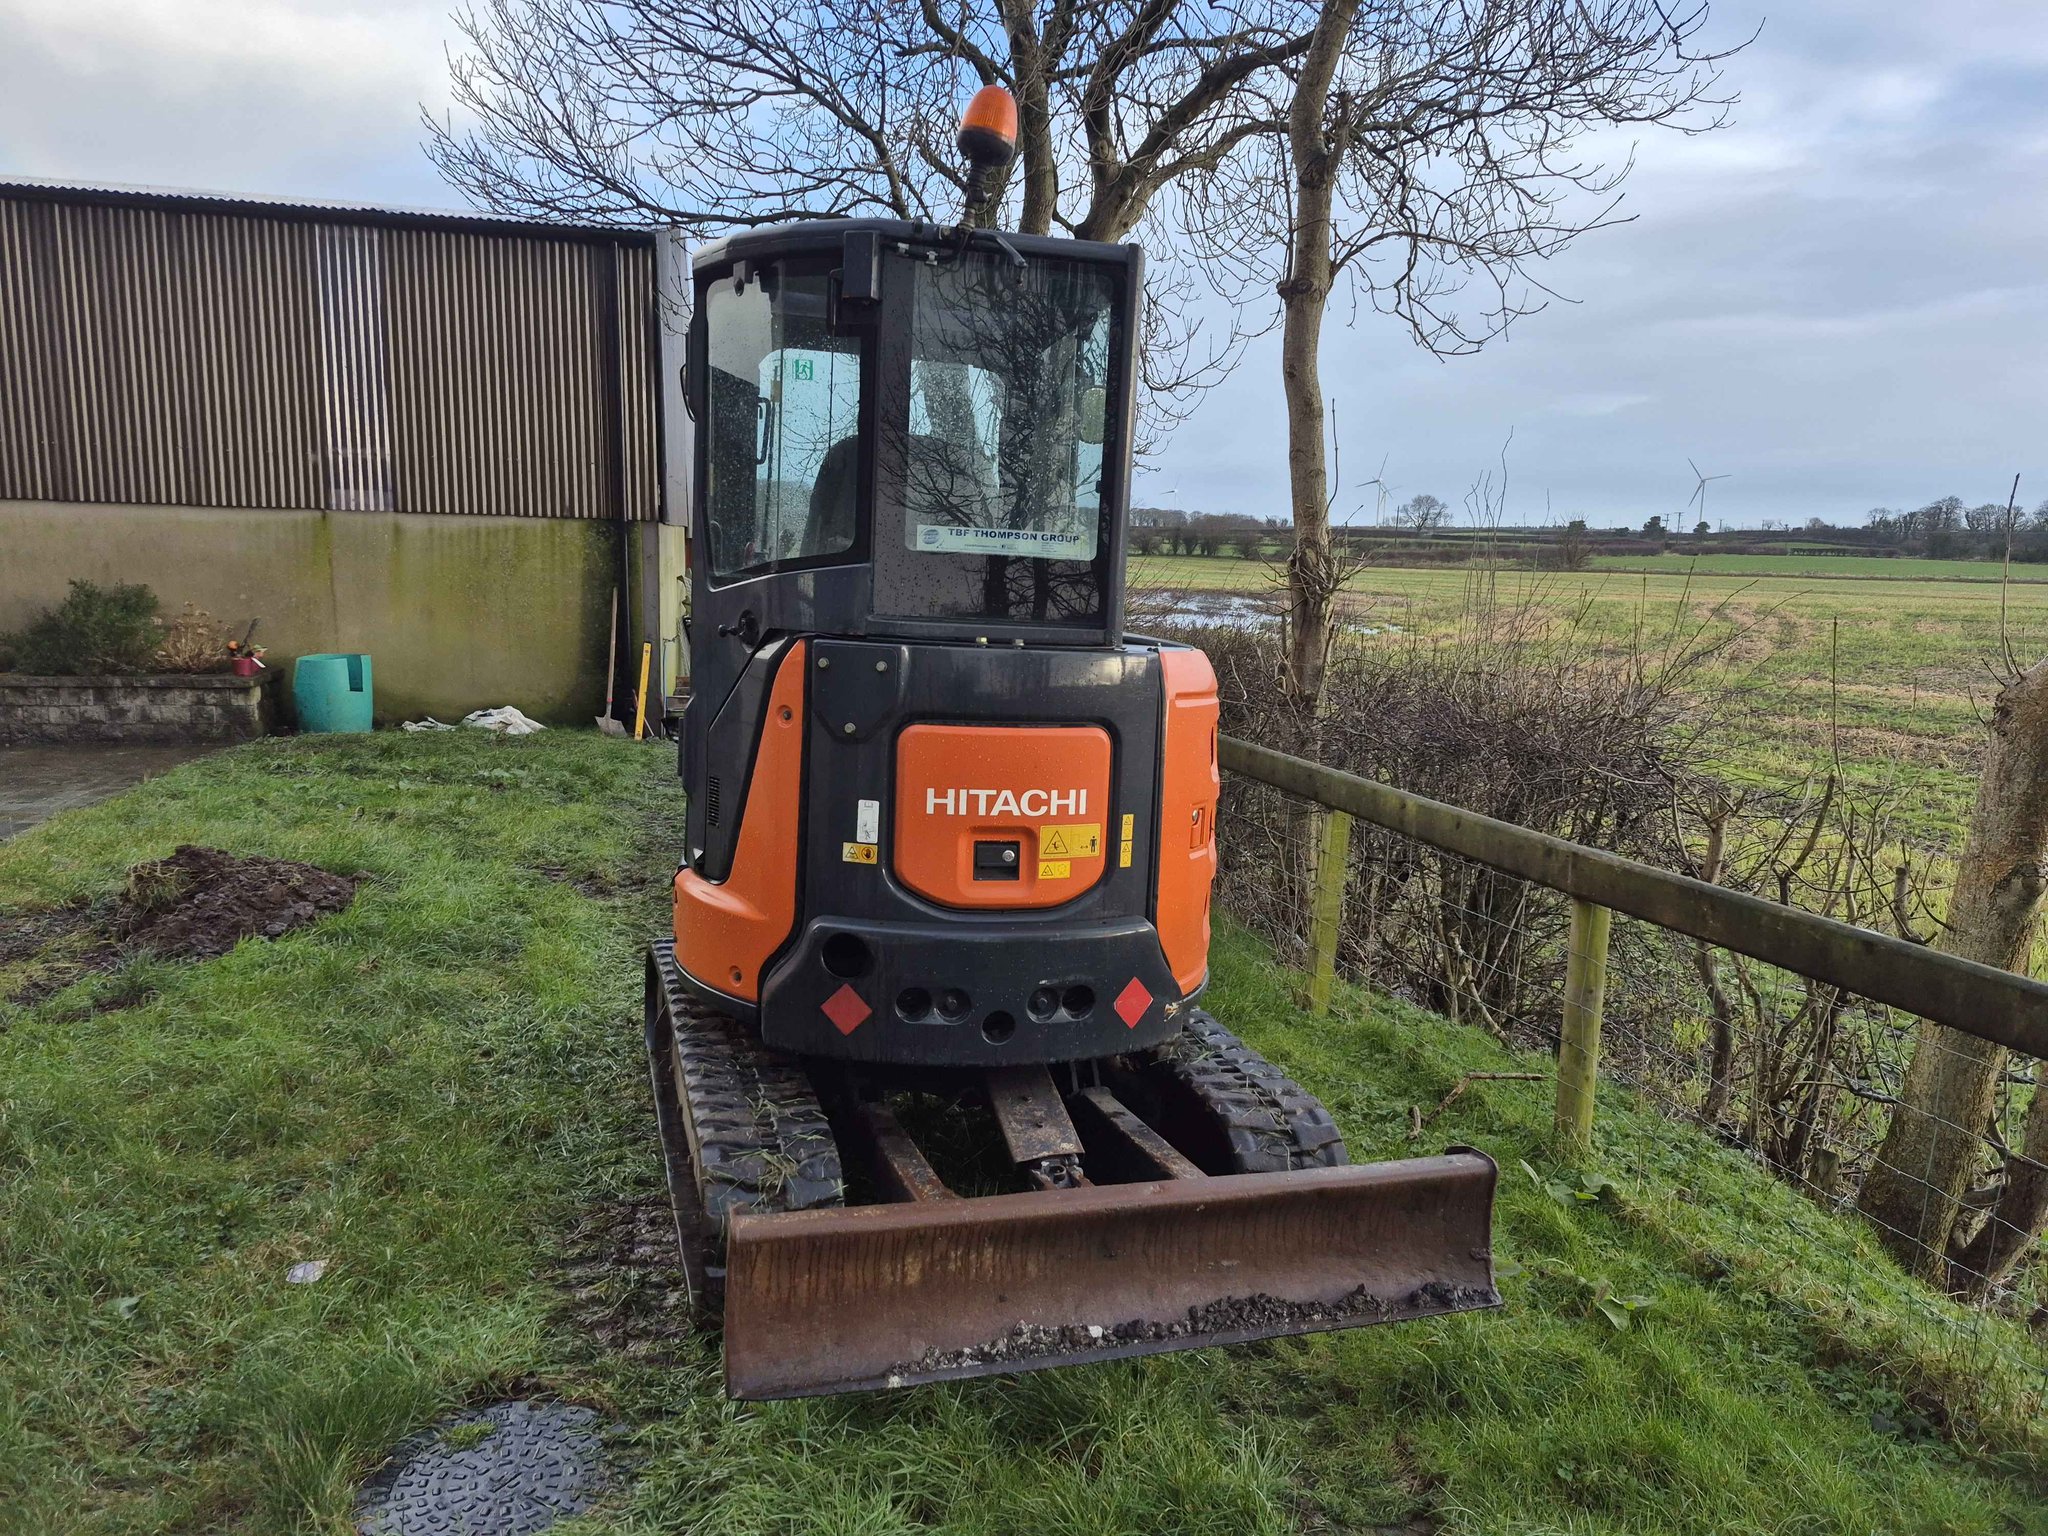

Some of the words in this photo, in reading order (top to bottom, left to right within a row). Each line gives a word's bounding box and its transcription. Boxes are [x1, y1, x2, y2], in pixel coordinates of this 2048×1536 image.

[947, 528, 970, 537] TBF
[973, 529, 1038, 541] THOMPSON
[1041, 533, 1080, 543] GROUP
[925, 787, 1087, 817] HITACHI
